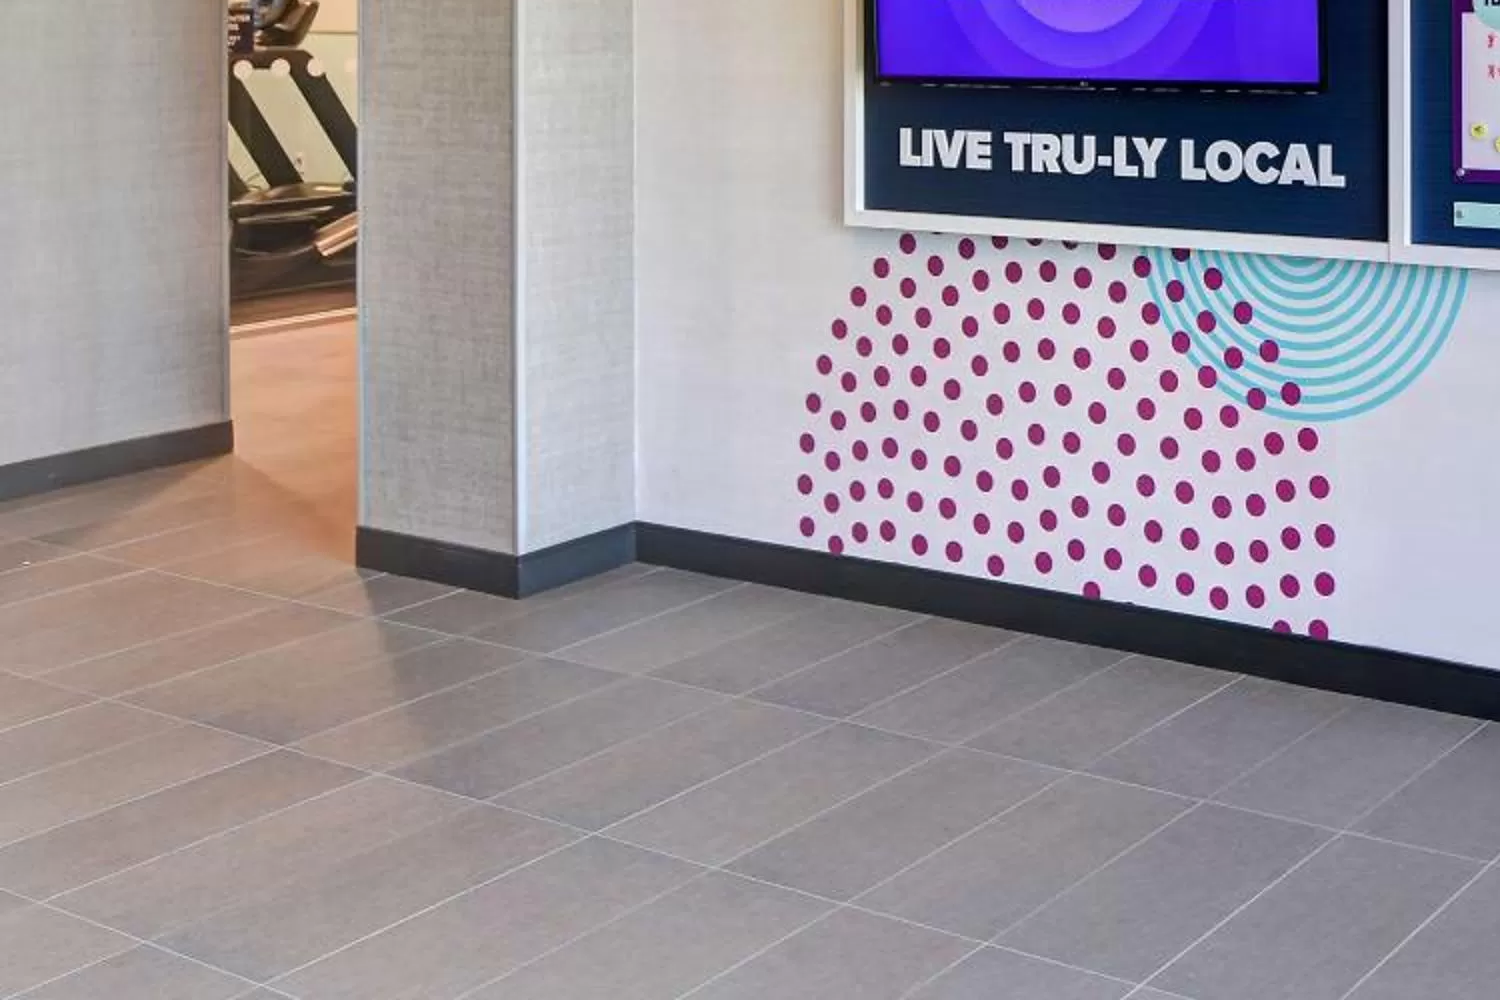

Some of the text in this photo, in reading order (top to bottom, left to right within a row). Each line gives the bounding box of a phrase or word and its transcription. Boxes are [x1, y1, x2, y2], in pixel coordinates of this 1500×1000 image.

[899, 128, 1347, 188] LIVE TRU-LY LOCAL
